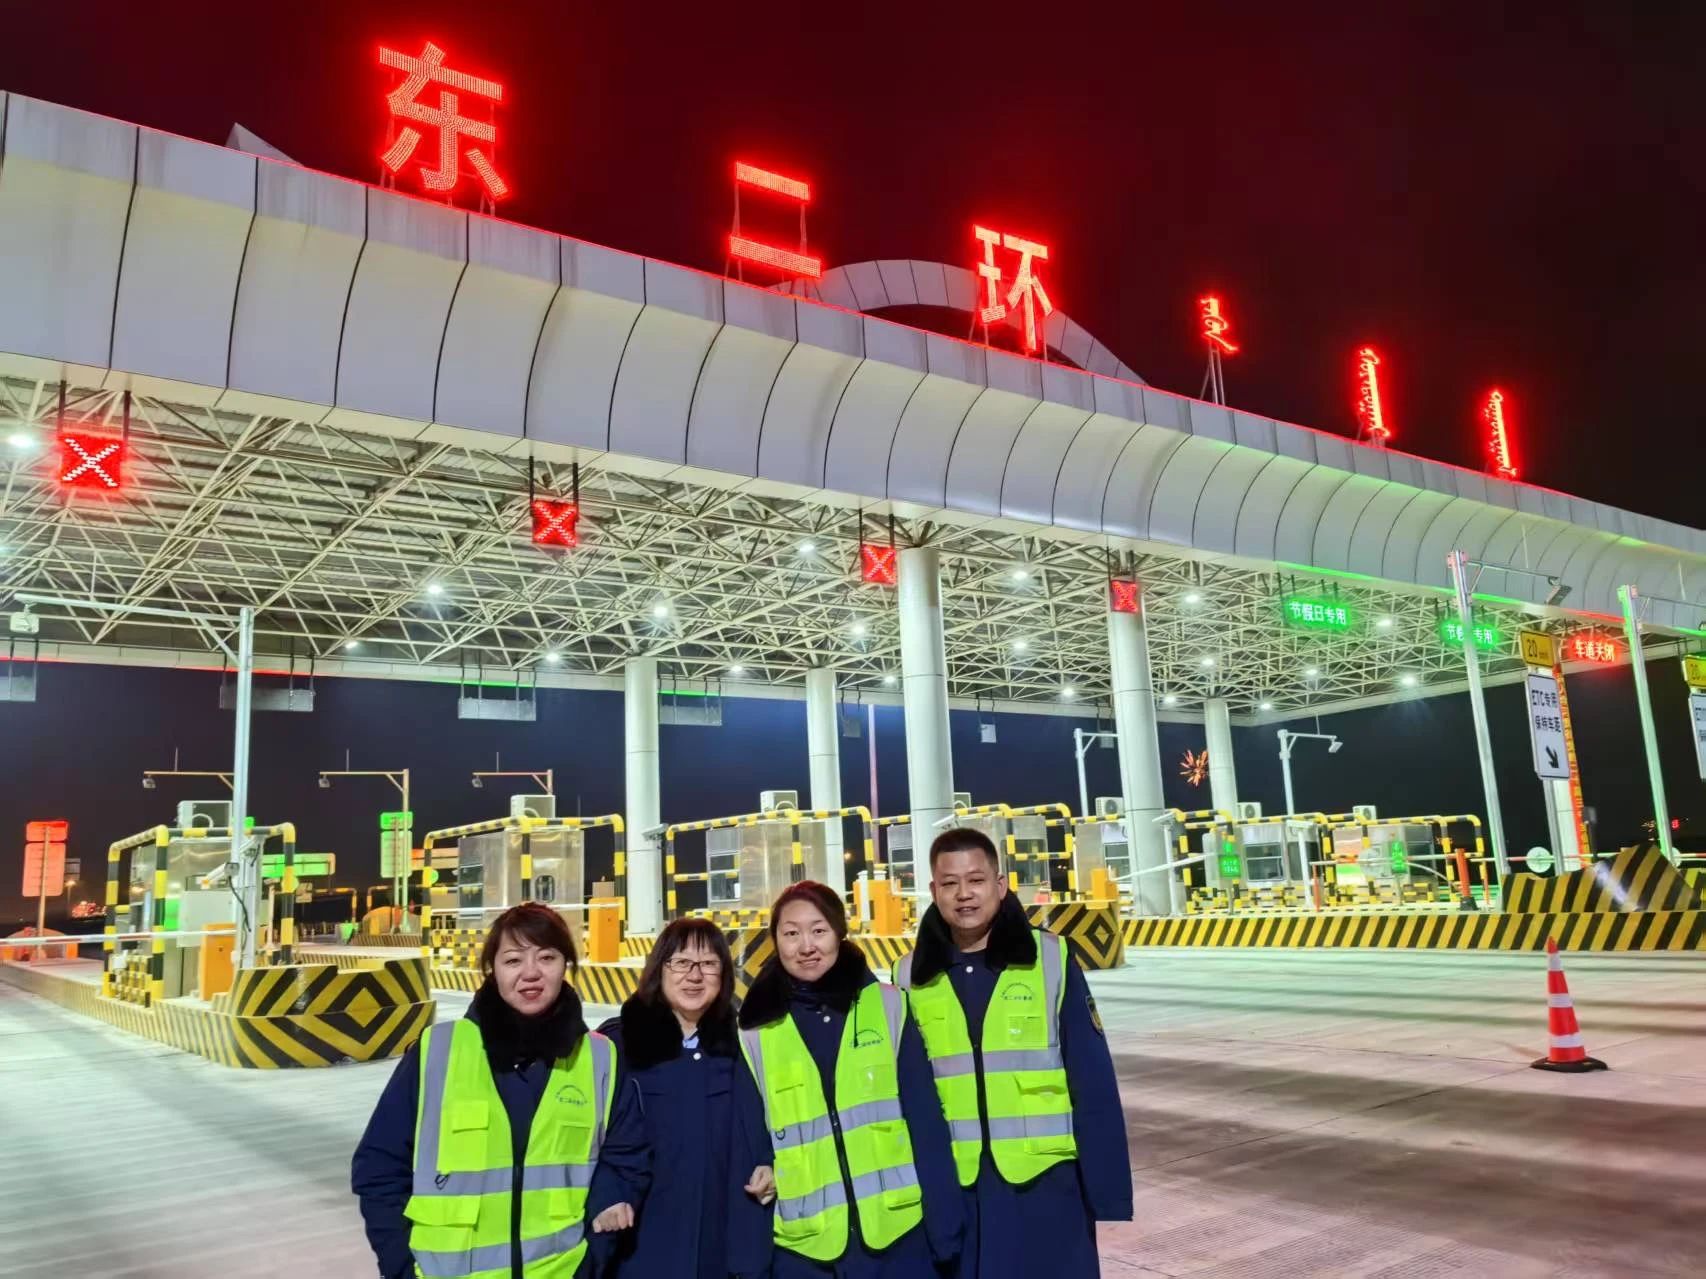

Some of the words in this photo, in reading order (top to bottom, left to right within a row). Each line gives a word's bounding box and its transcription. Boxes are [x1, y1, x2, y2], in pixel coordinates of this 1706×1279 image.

[1288, 601, 1347, 626] 节假日专用
[1445, 623, 1493, 645] 节假专用
[1575, 639, 1615, 662] 车道关闭
